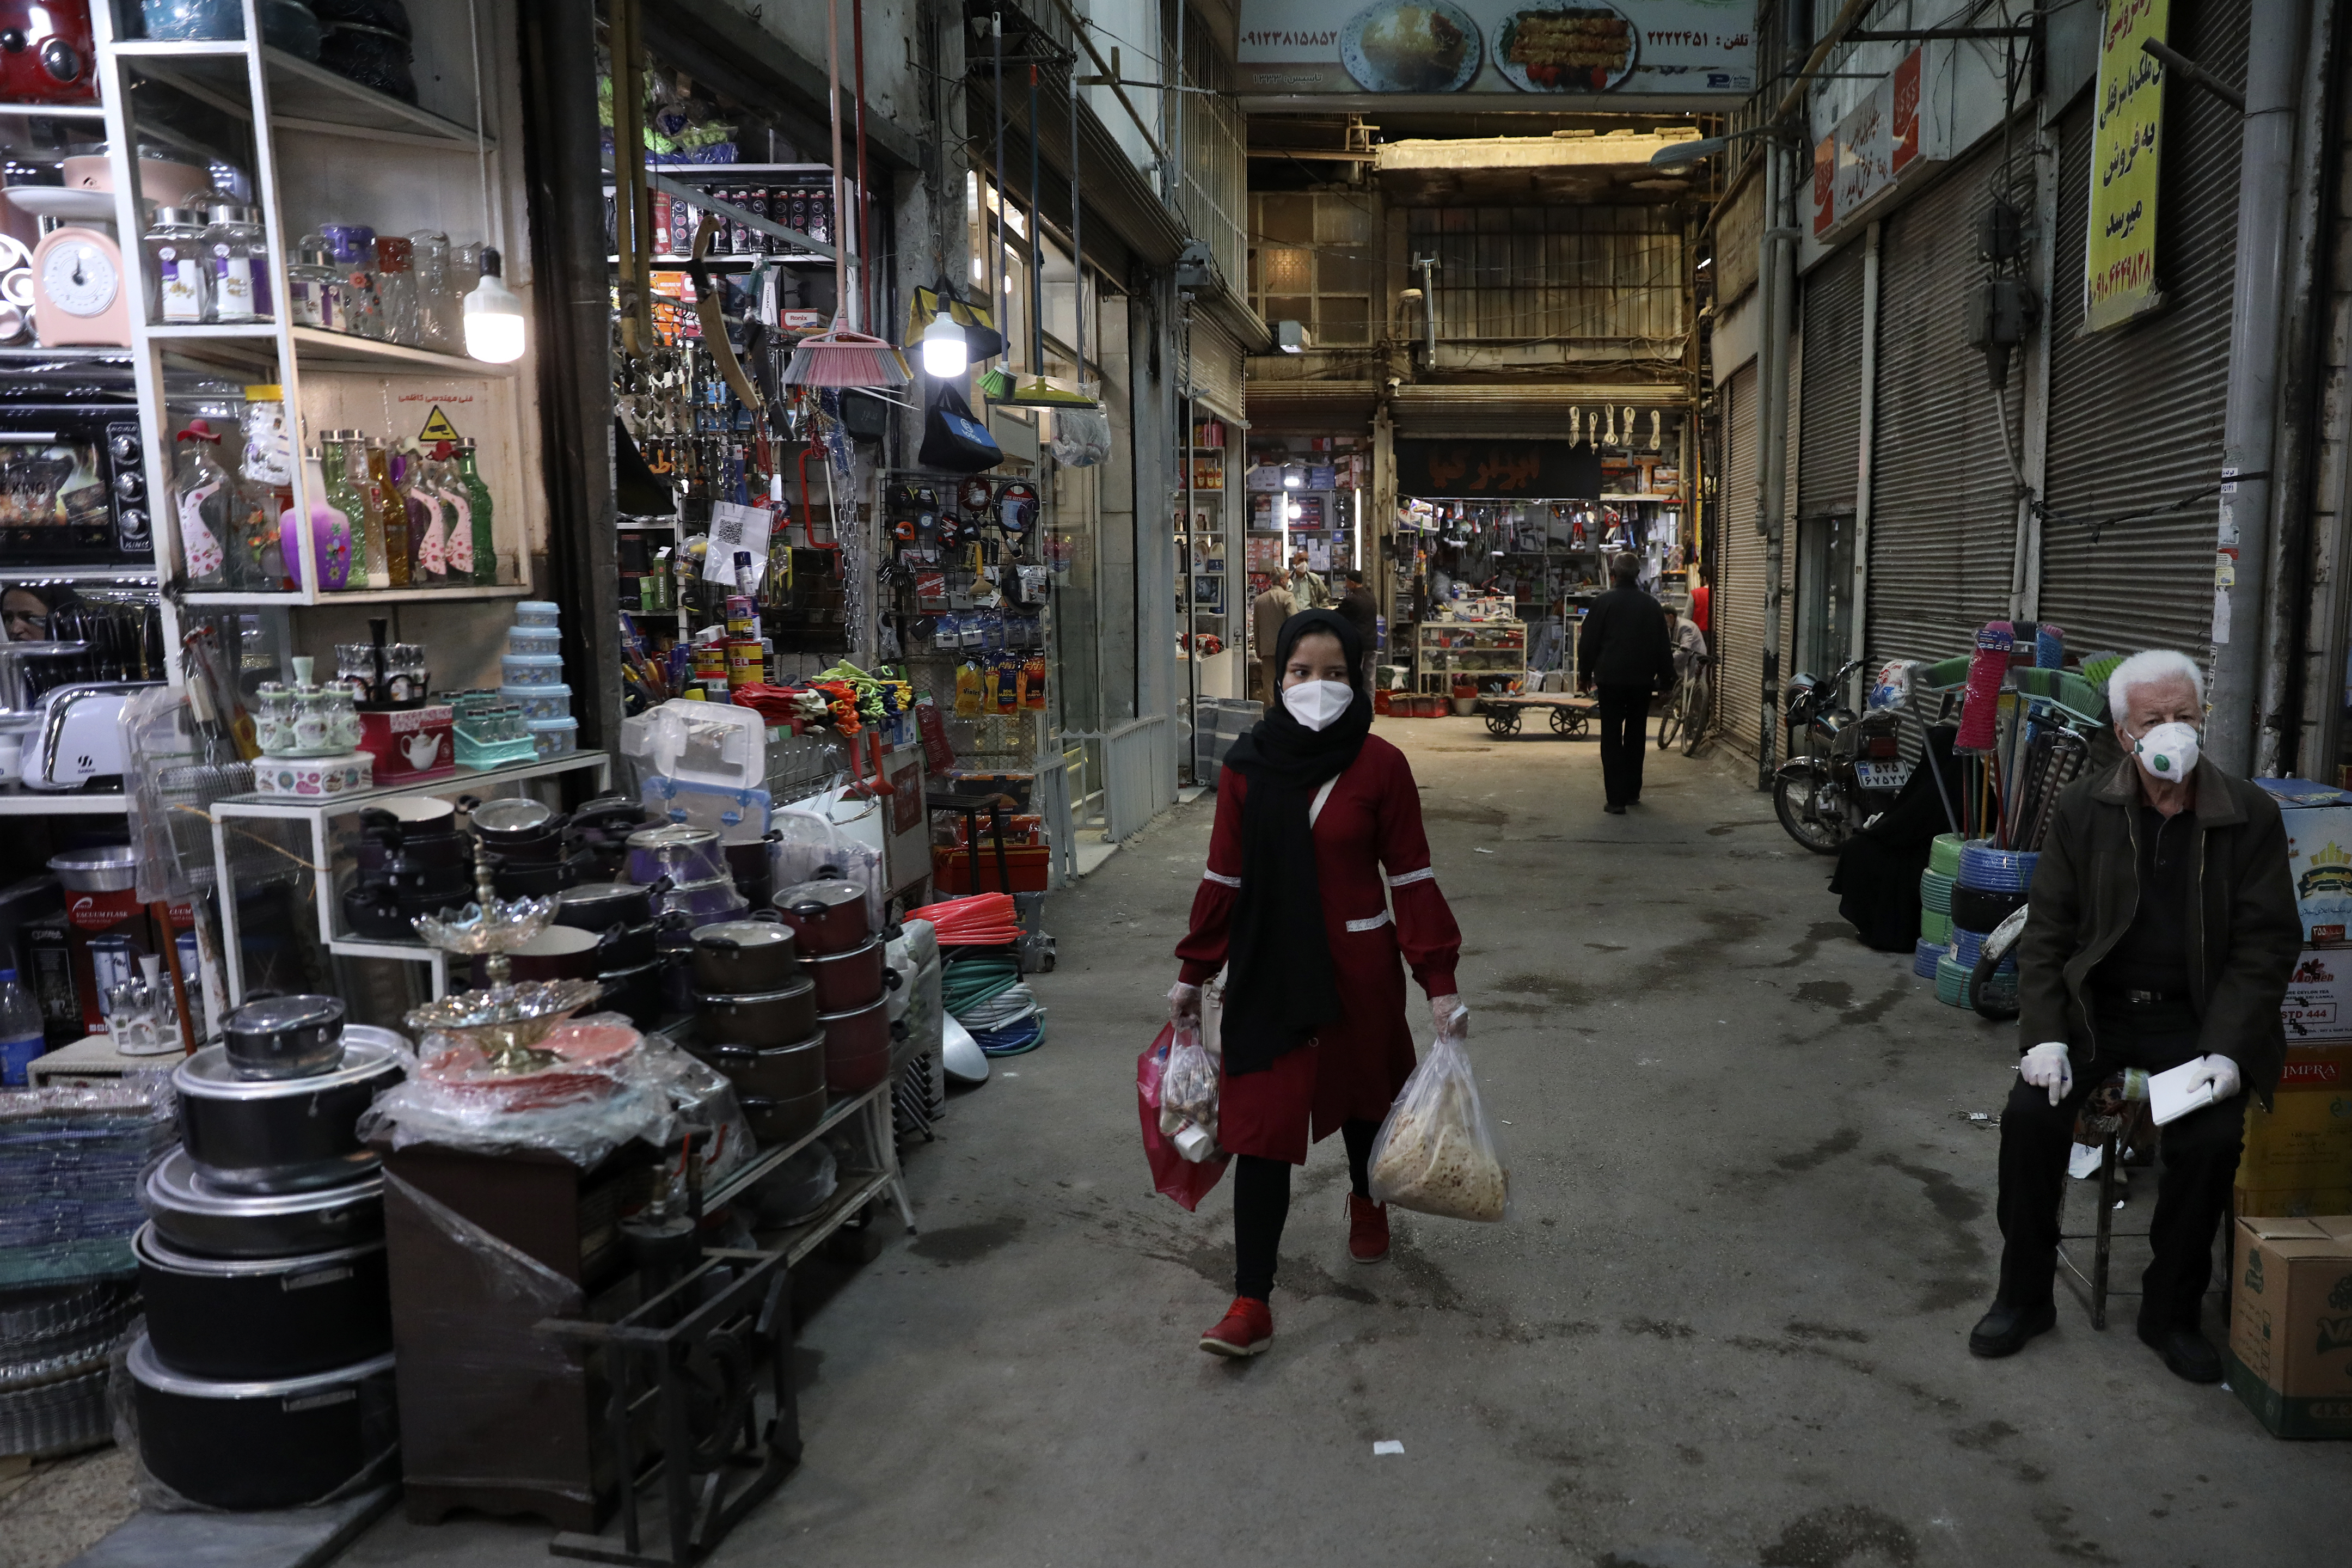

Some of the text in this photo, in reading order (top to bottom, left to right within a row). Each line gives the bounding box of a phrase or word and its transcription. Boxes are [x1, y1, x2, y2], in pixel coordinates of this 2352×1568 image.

[1241, 30, 1337, 46] ۰۹۱۲۳۸۱۵۸۵۲
[1647, 31, 1708, 46] ۲۲۲۲۴۵۱
[2103, 121, 2155, 187] به فروش
[2106, 200, 2142, 239] میرسد
[124, 540, 150, 549] KING
[2281, 1010, 2327, 1019] STD 444
[2283, 1064, 2336, 1080] IMPRA
